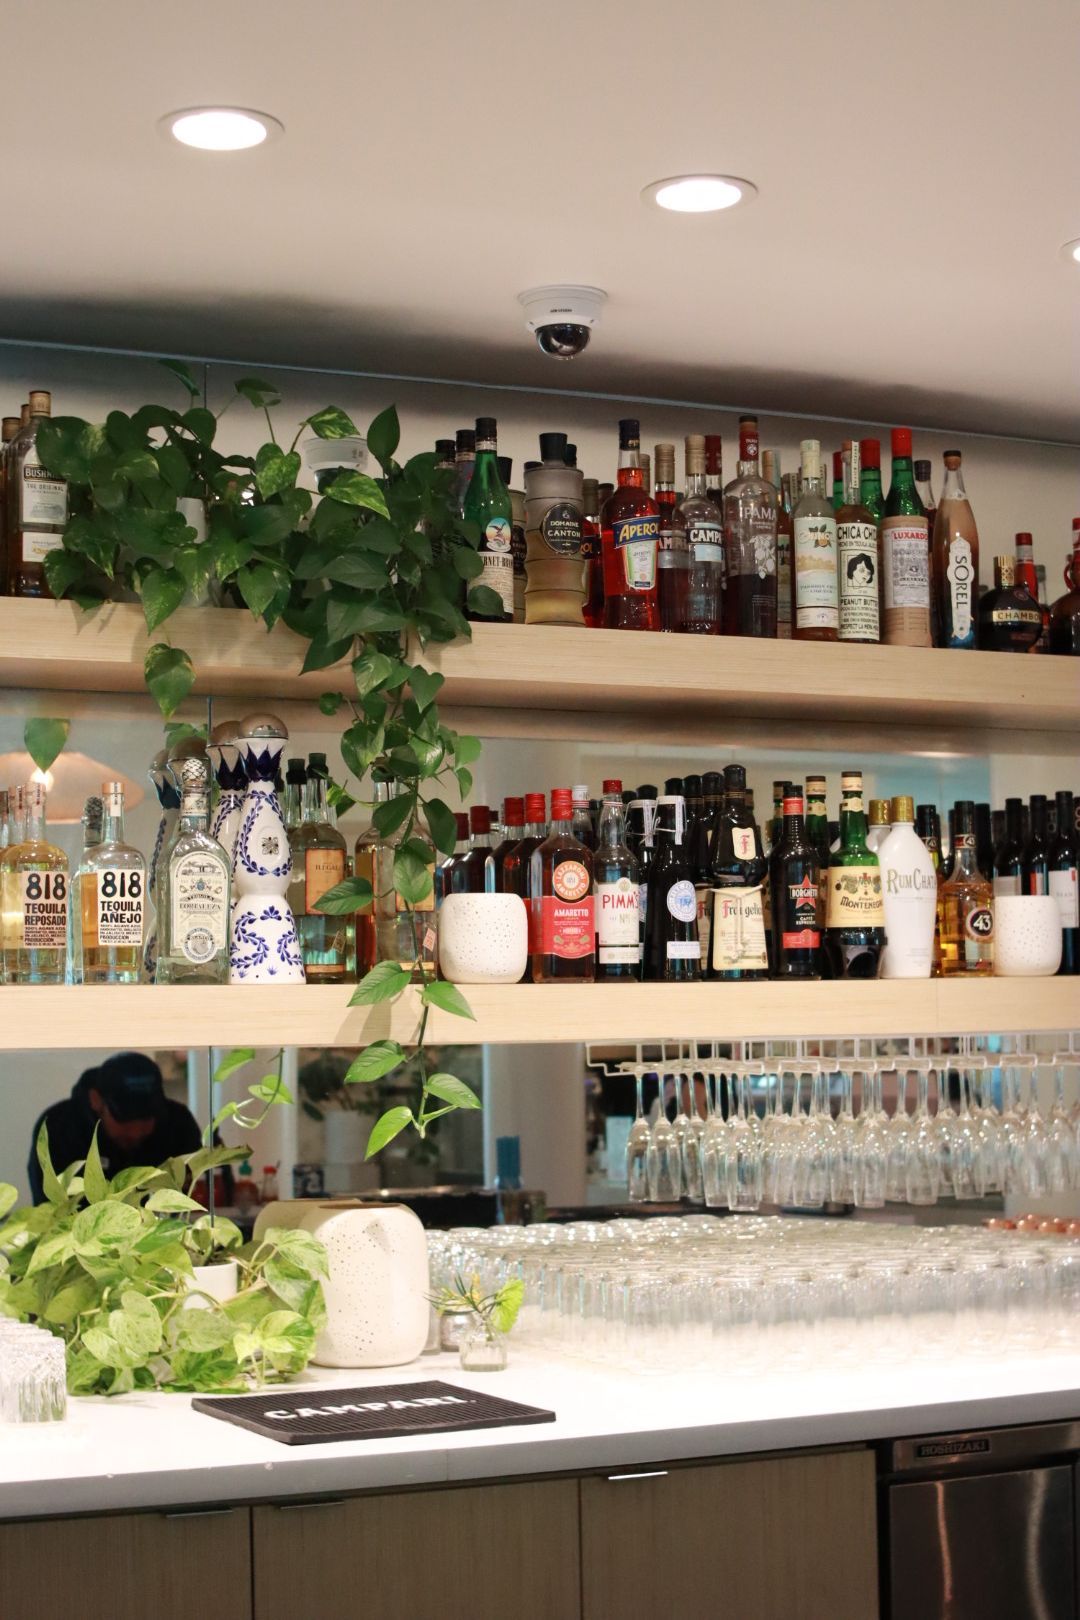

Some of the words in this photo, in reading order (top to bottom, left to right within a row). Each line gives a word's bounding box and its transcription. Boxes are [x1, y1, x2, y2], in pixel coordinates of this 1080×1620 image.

[39, 484, 64, 492] ORIGINAL
[744, 506, 777, 521] PAMA
[893, 531, 928, 540] LUXARDO
[954, 555, 970, 609] SOREL
[26, 873, 67, 901] 818
[101, 871, 142, 898] 818
[25, 903, 67, 914] TEQUILA
[100, 901, 142, 913] TEQUILA
[554, 908, 589, 917] AMARETTO
[25, 915, 67, 926] REPOSADO
[101, 912, 142, 923] AÑEJO
[973, 915, 991, 931] 43
[263, 1395, 468, 1420] CAMPARI
[920, 1441, 986, 1456] HOSHIZAKI
